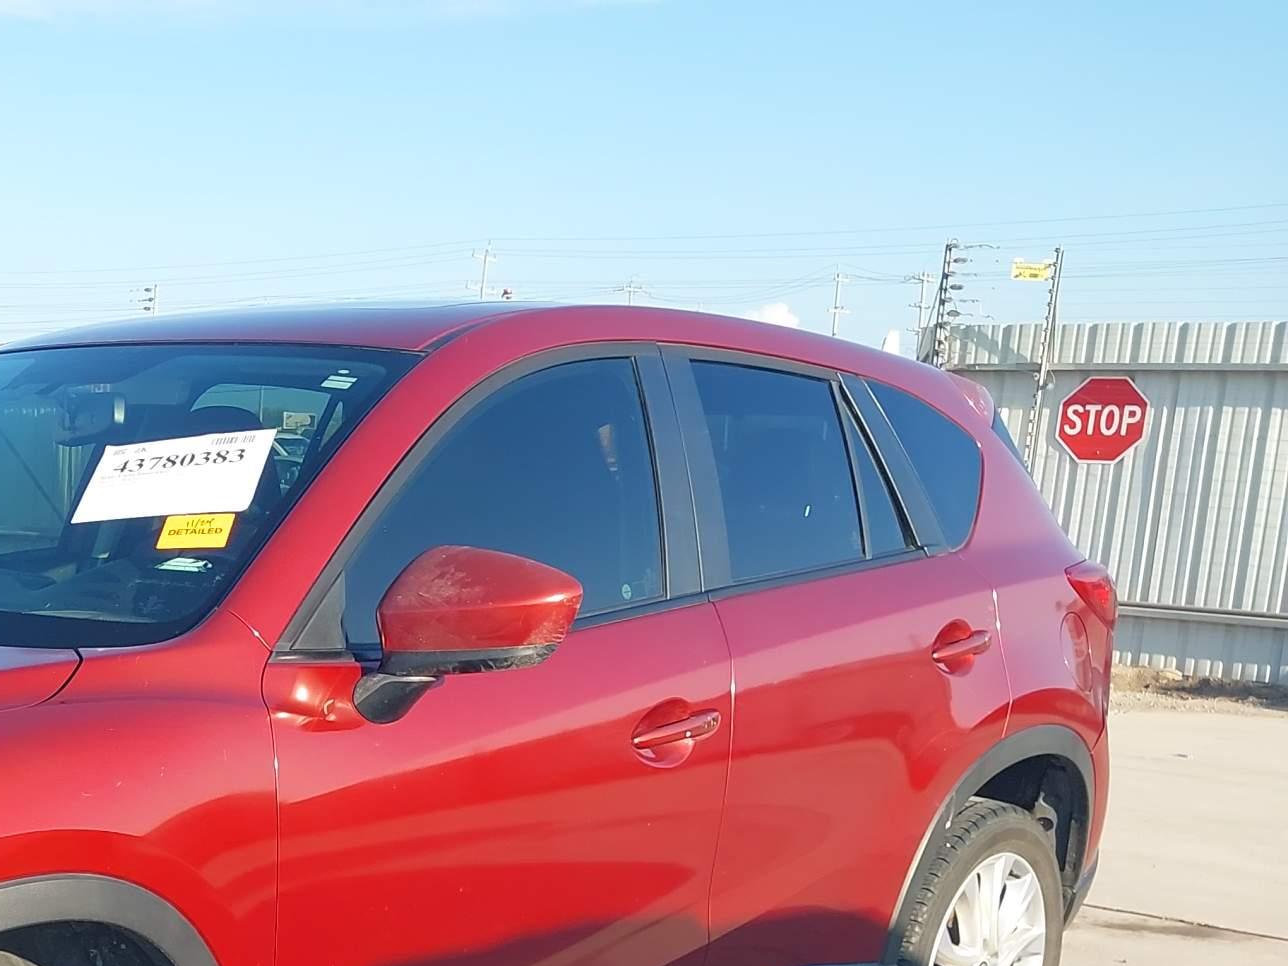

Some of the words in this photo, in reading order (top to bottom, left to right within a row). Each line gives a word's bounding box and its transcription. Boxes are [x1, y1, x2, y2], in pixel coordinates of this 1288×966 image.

[1063, 404, 1142, 436] STOP
[113, 448, 246, 473] 43780383
[167, 527, 223, 536] DETAILED
